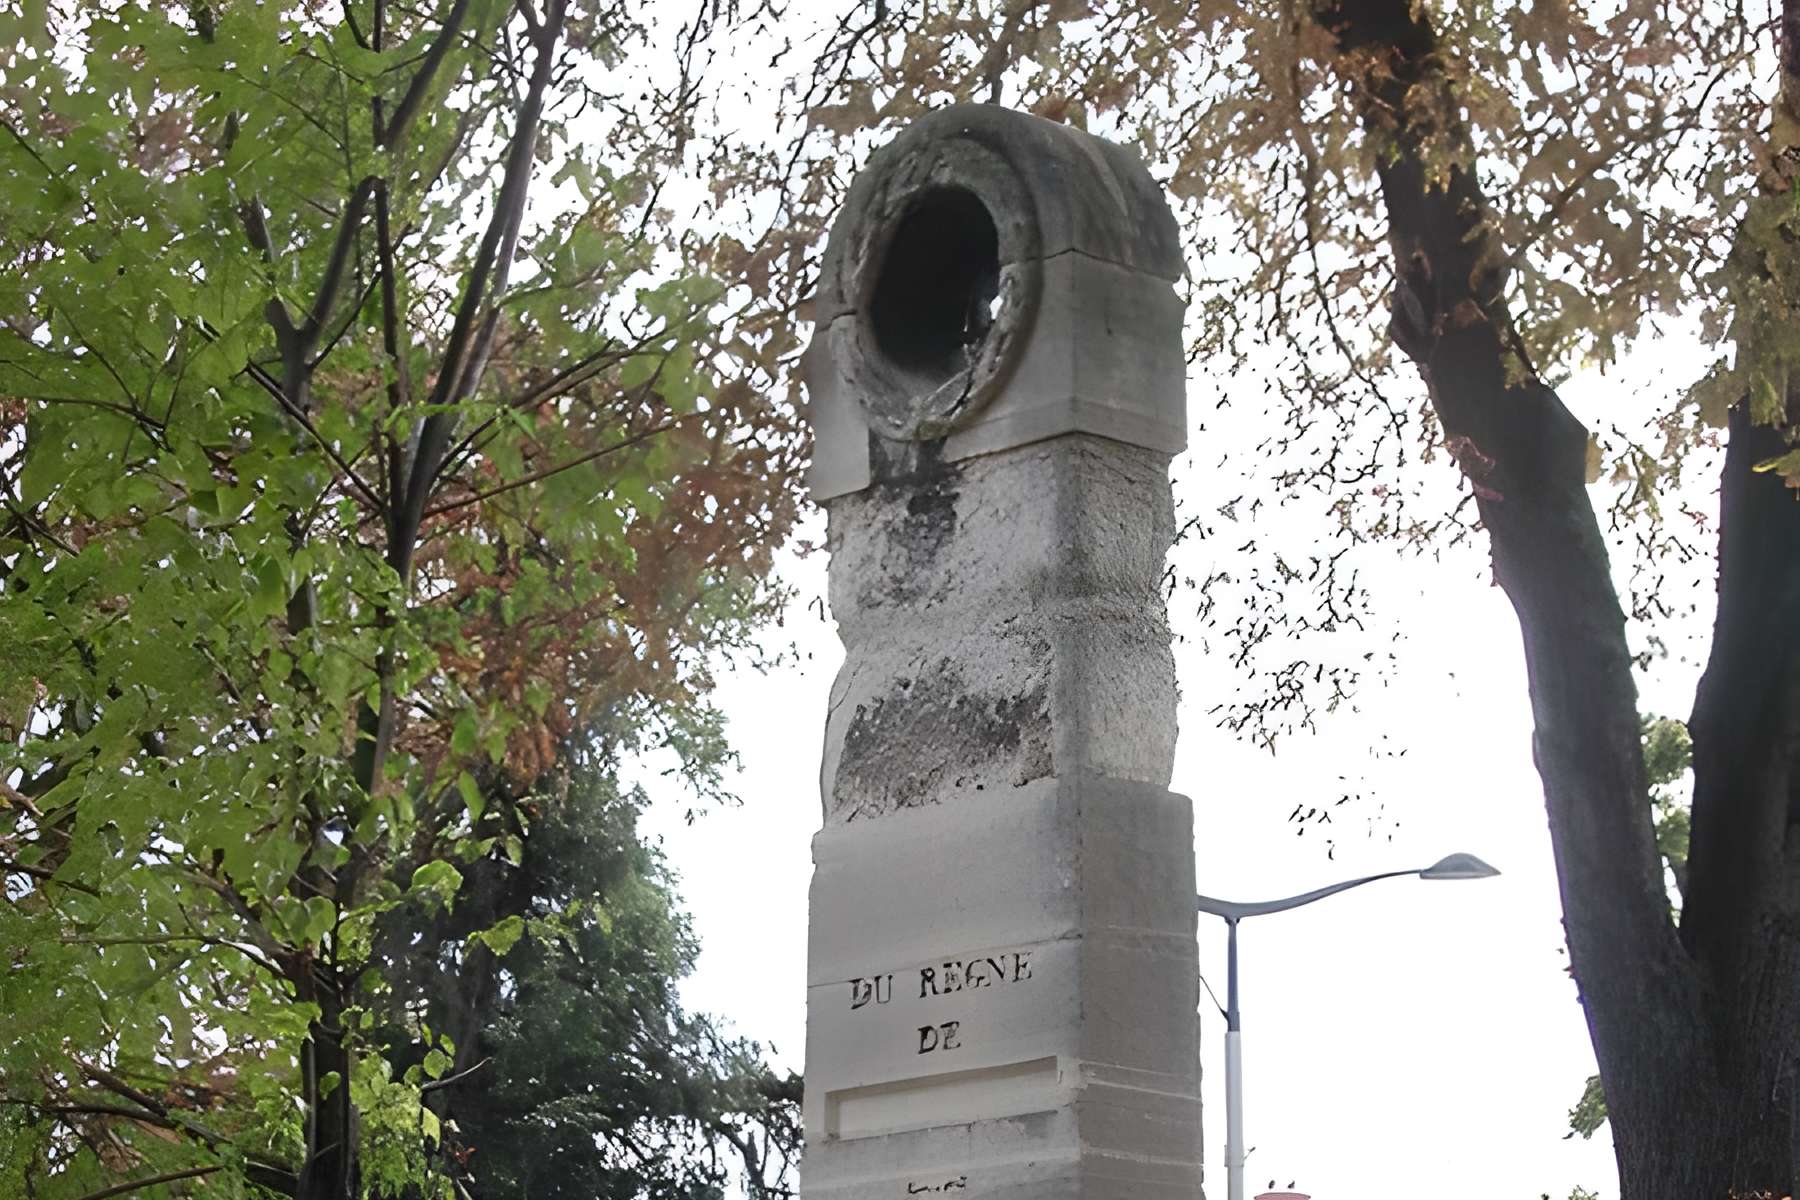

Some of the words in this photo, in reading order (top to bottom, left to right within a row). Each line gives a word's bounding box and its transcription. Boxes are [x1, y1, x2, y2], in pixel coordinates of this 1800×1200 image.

[849, 974, 893, 1009] DU
[919, 951, 1033, 998] REGNE
[917, 1021, 961, 1054] DE
